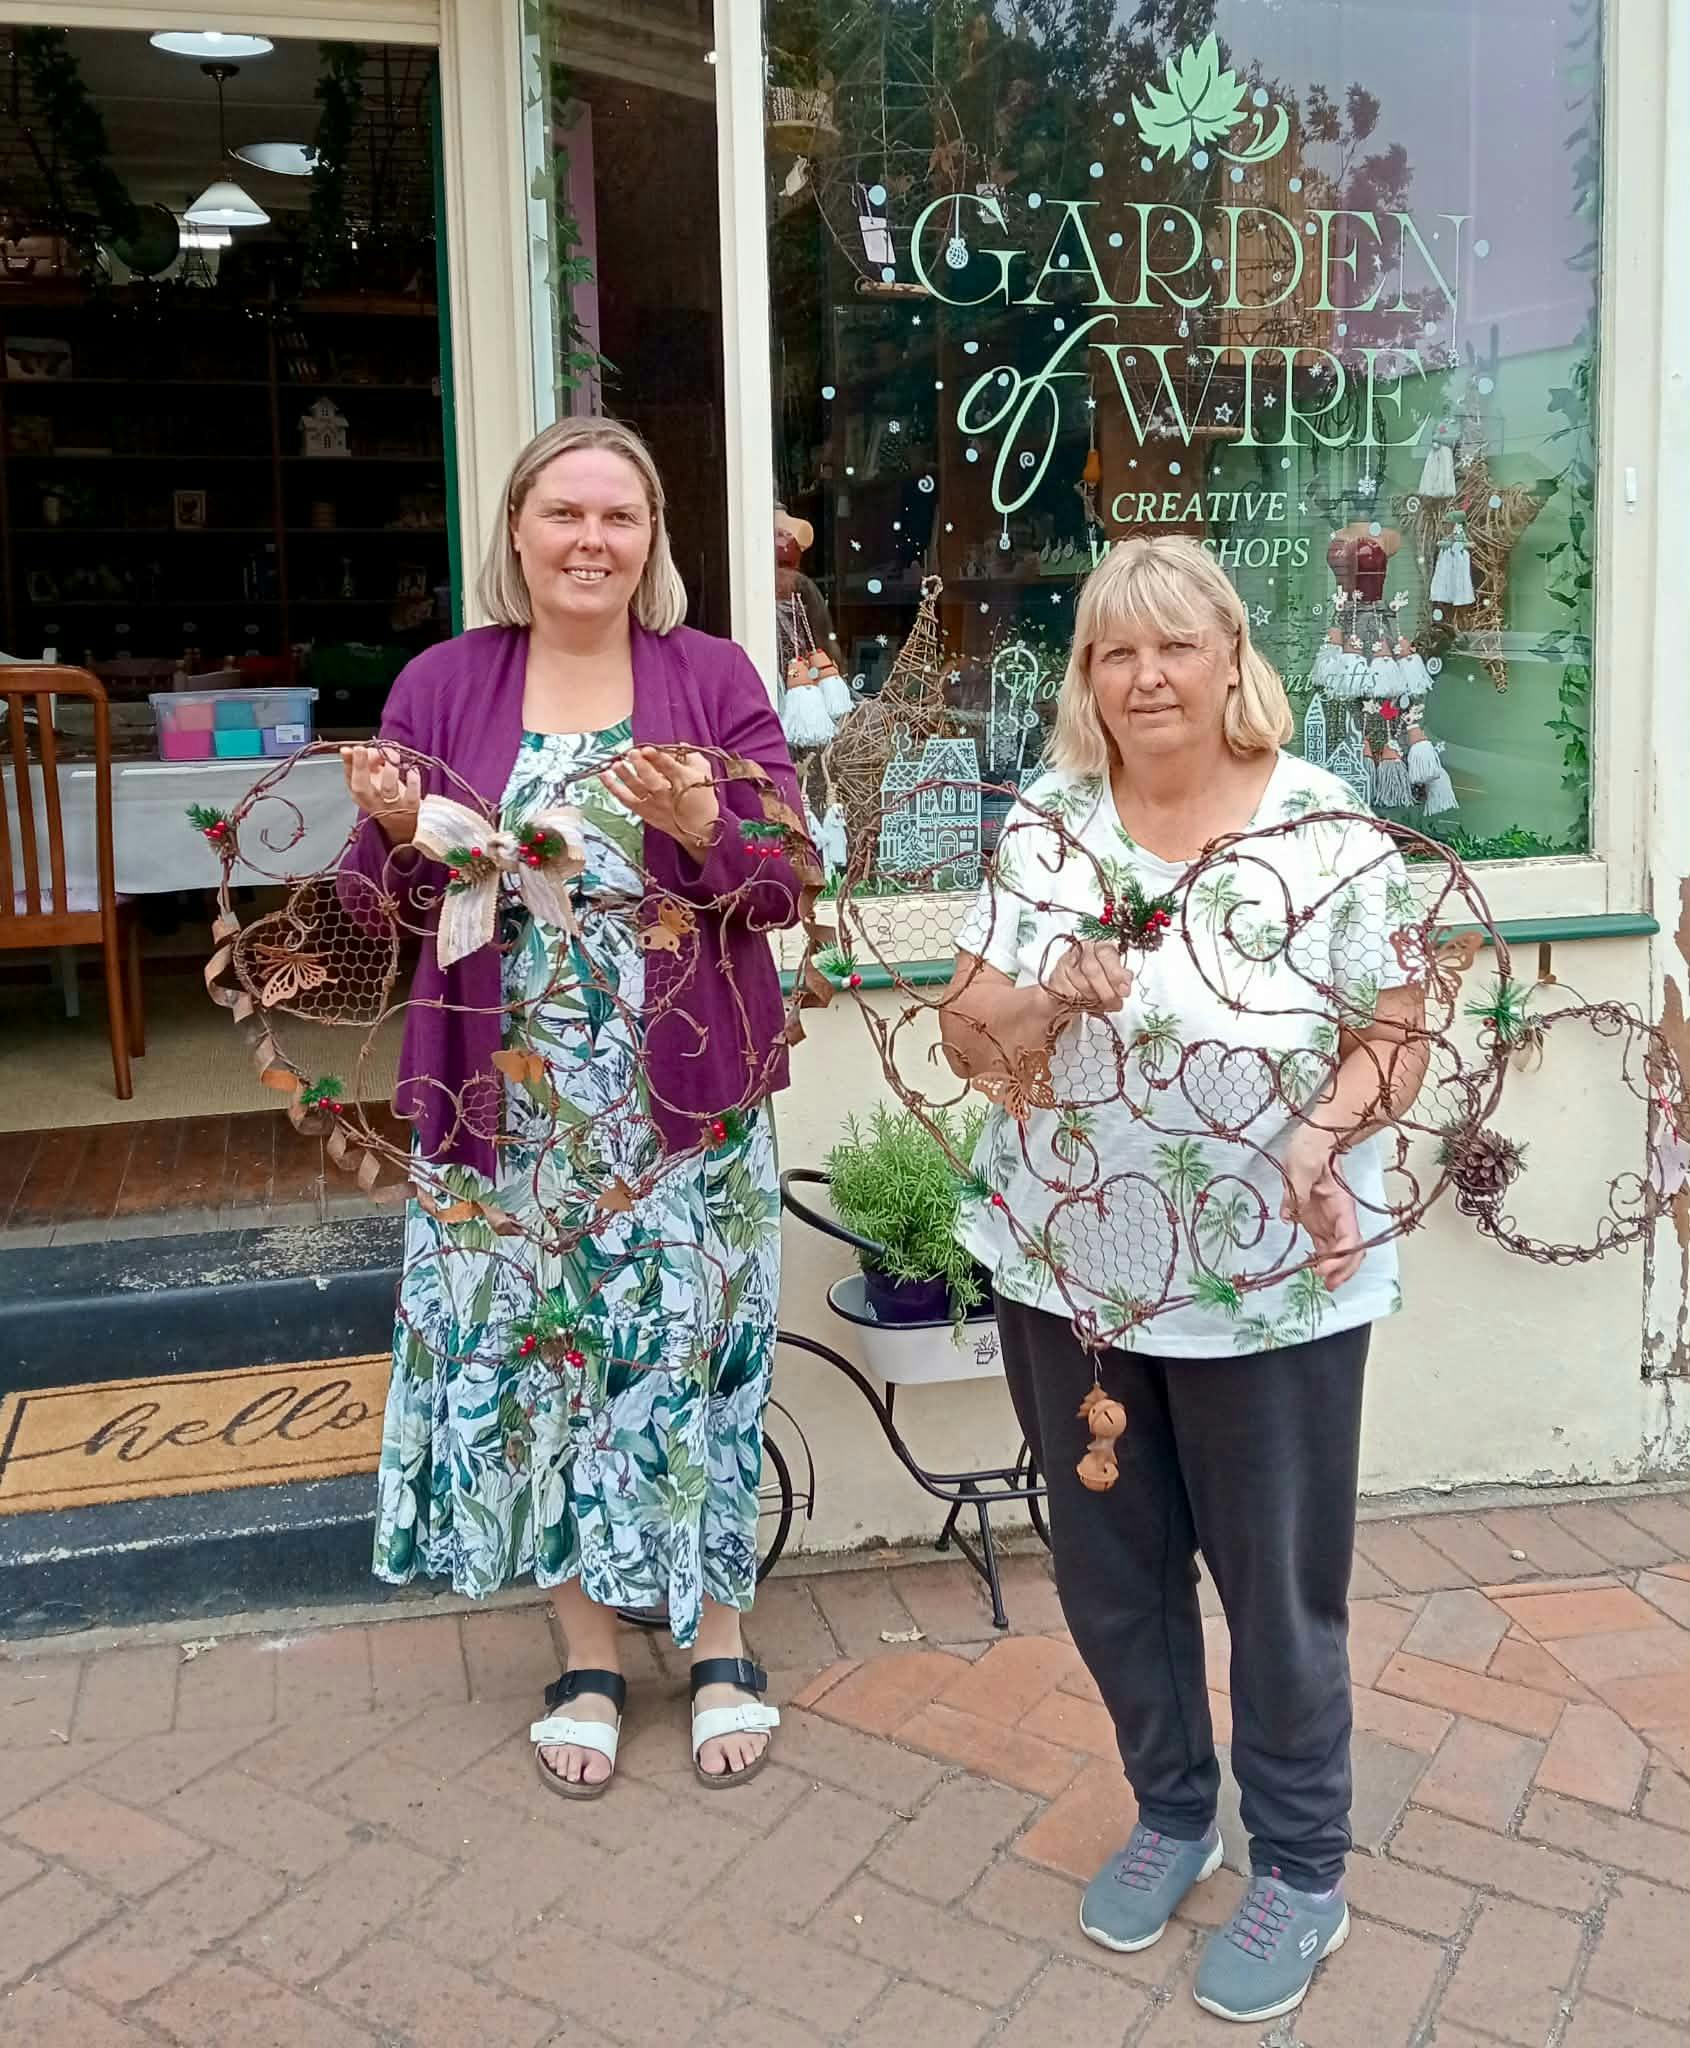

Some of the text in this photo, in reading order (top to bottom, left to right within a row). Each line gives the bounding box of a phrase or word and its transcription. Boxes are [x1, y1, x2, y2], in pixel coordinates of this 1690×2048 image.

[909, 193, 1473, 313] GARDEN
[957, 313, 1432, 513] of WIRE
[1111, 492, 1288, 523] CREATIVE
[1090, 537, 1311, 569] WSHOPS
[70, 1380, 384, 1463] hello
